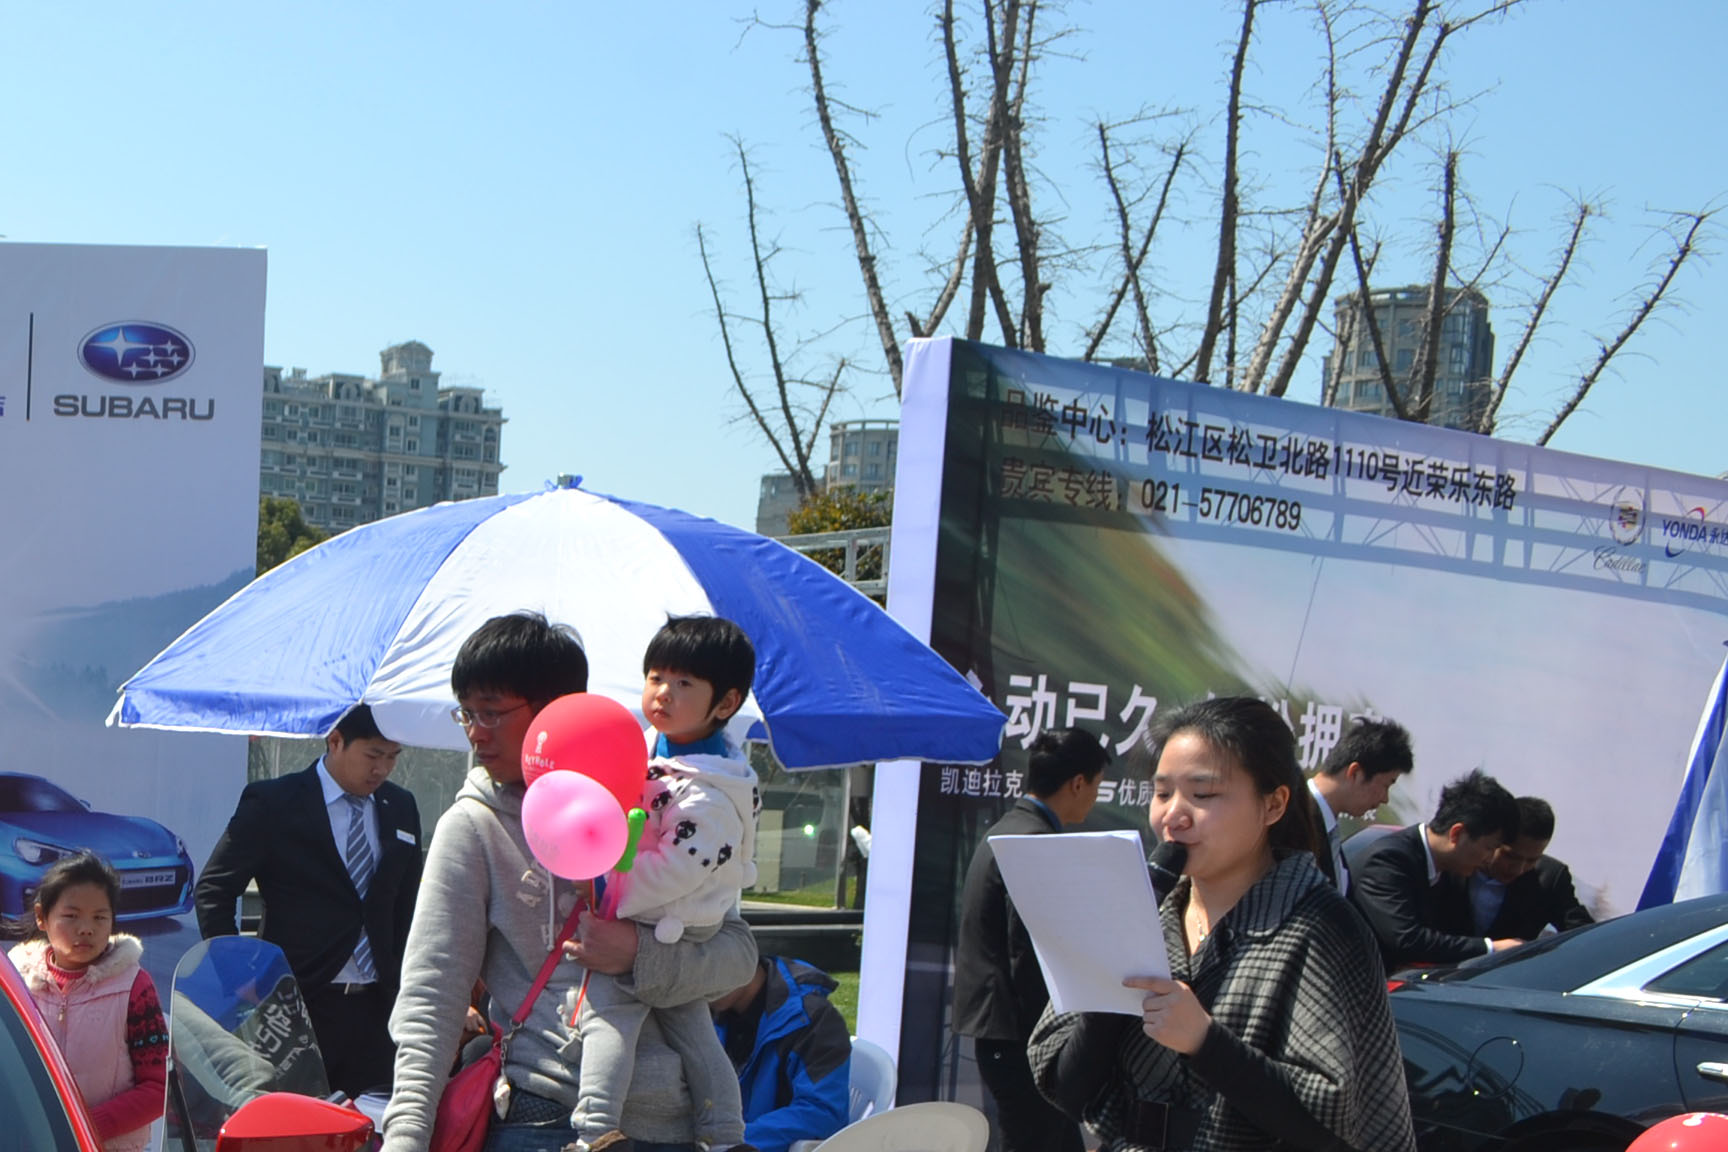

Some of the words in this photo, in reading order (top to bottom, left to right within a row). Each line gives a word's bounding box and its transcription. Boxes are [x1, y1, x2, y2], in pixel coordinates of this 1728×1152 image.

[53, 393, 215, 421] SUBARU
[1662, 519, 1707, 543] YONDA
[1592, 545, 1646, 575] Cadillac
